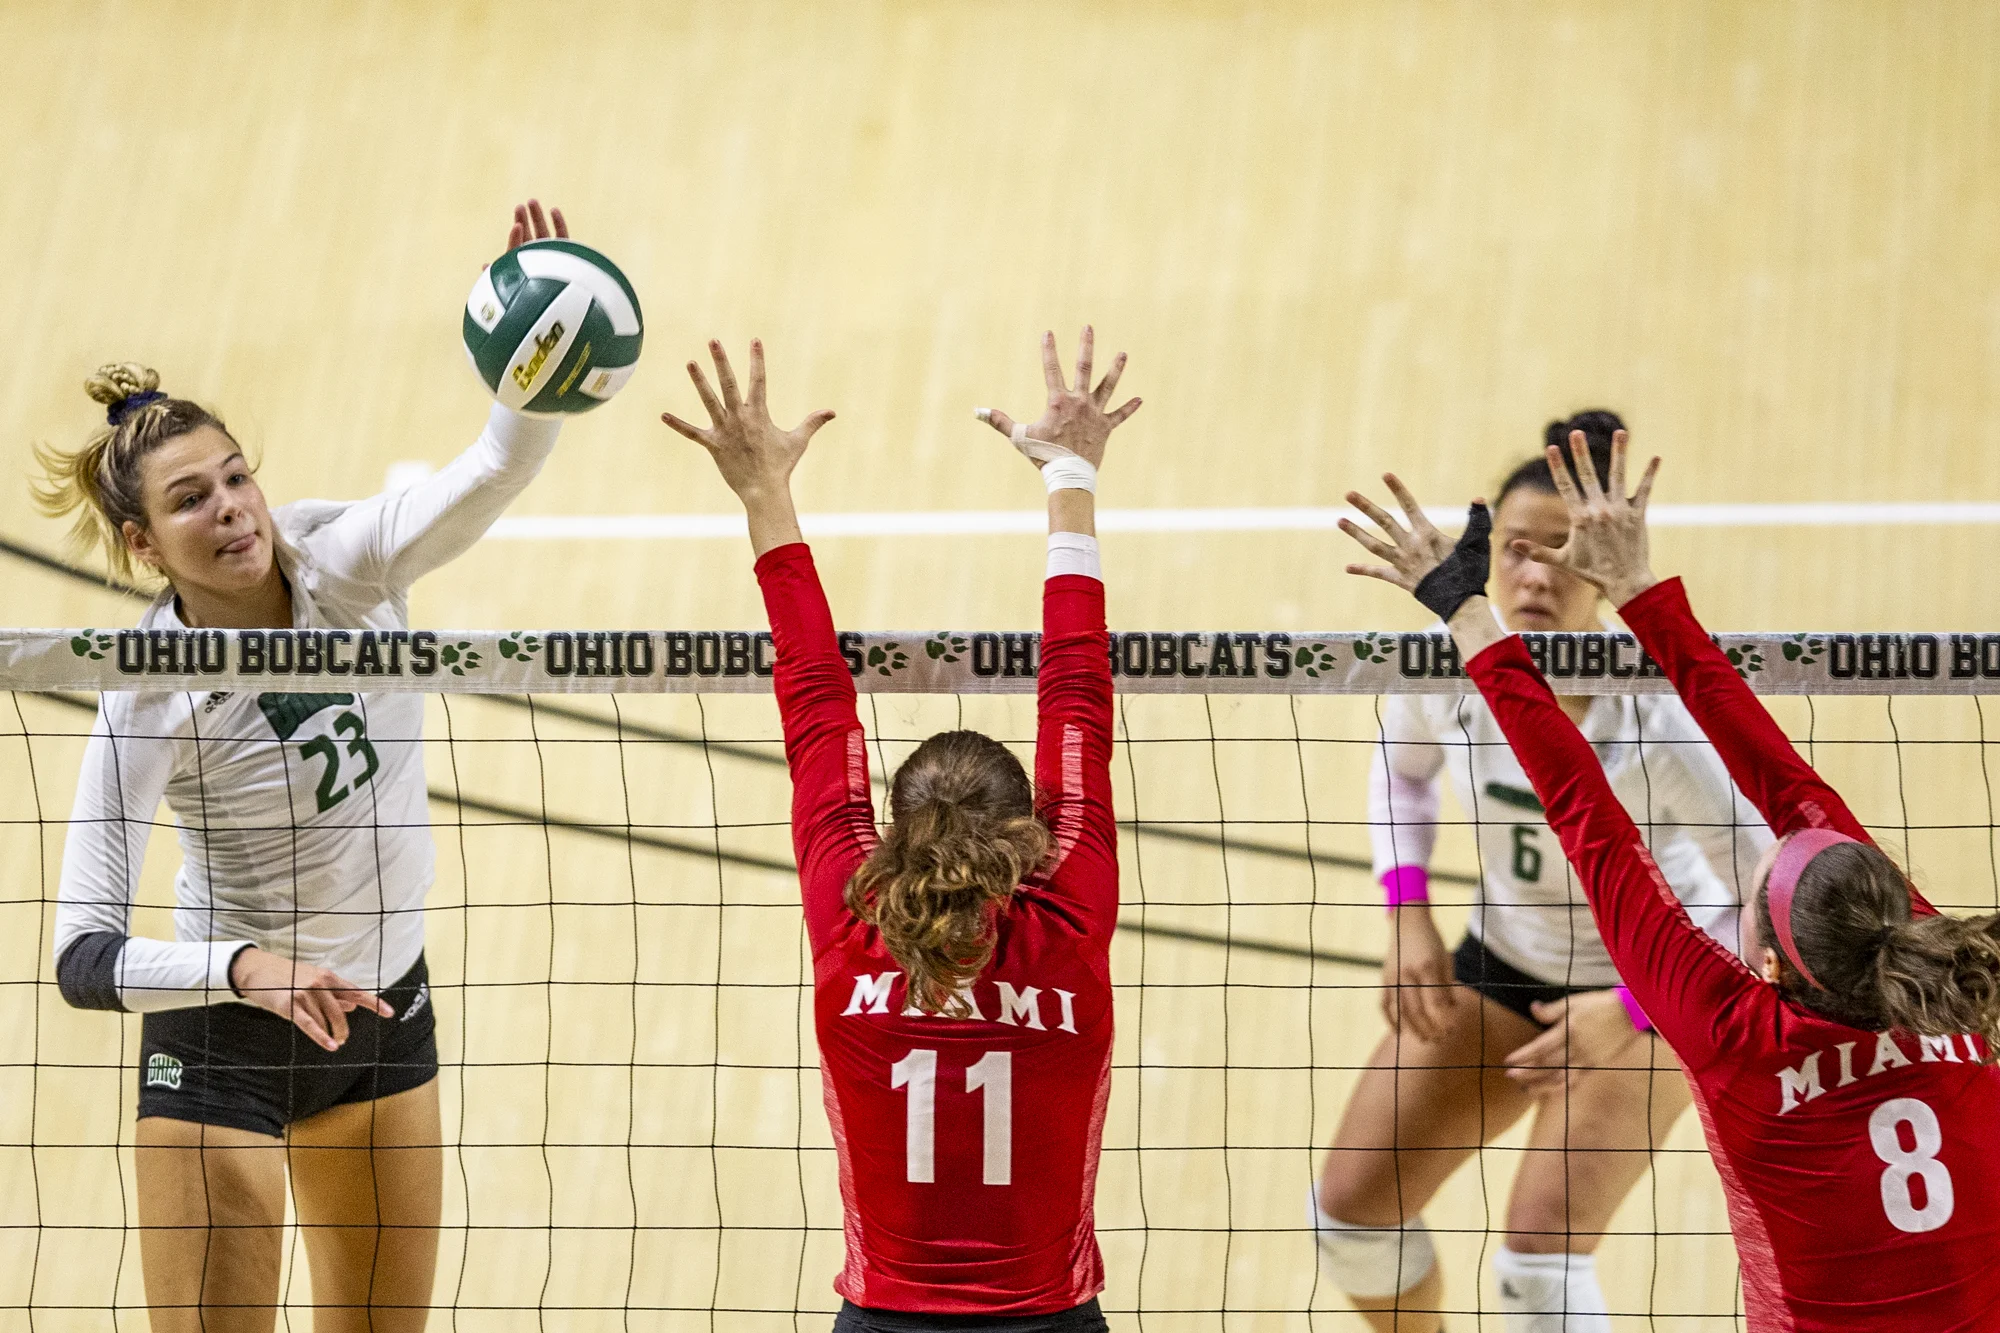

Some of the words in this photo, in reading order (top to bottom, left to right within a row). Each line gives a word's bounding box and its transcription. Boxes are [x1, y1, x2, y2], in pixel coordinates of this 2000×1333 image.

[117, 630, 227, 675] OHIO
[238, 630, 439, 677] BOBCATS
[545, 631, 652, 677] OHIO
[665, 631, 865, 677] BOBCS
[972, 631, 1042, 678] OH
[1400, 632, 1469, 678] OH
[1828, 633, 1937, 679] OHIO
[298, 711, 379, 813] 23
[1512, 826, 1542, 882] 6
[1775, 1031, 1982, 1116] MIAMI
[891, 1049, 1012, 1185] 11
[1868, 1098, 1954, 1233] 8
